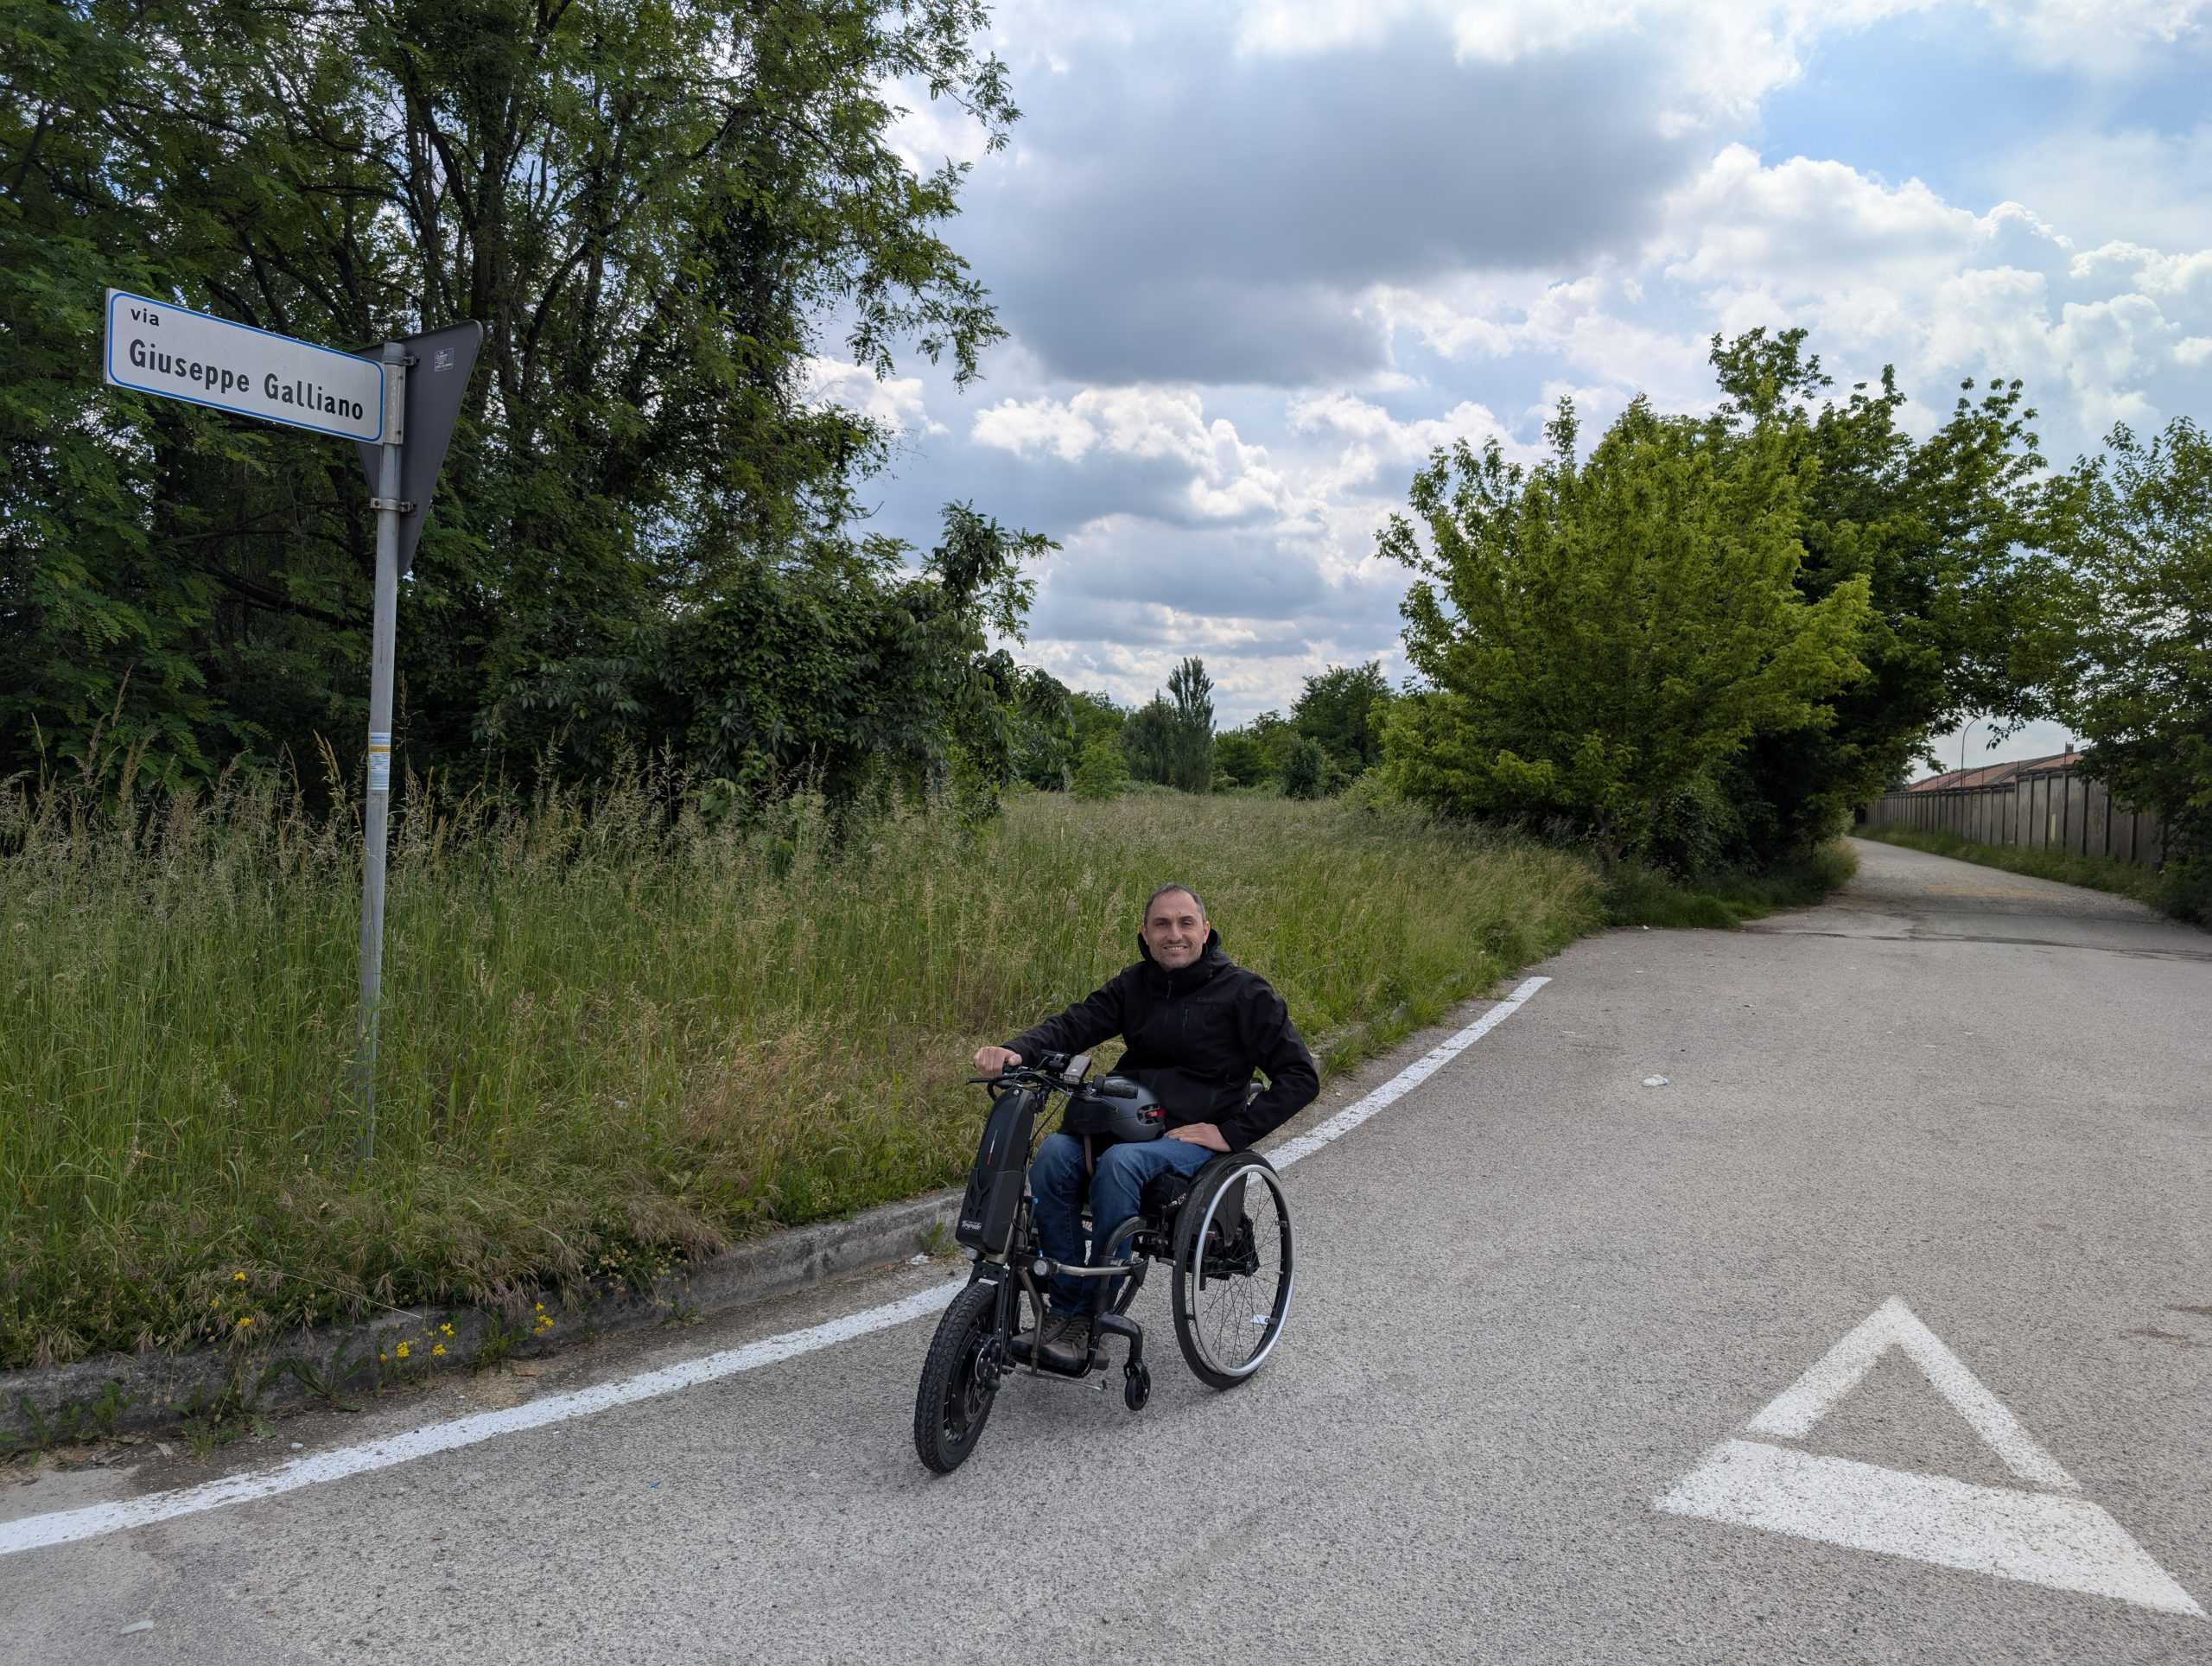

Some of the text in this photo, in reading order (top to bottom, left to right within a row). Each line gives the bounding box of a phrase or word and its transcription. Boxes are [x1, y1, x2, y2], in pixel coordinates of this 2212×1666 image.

[130, 308, 160, 327] via
[130, 339, 364, 420] Giuseppe Galliano
